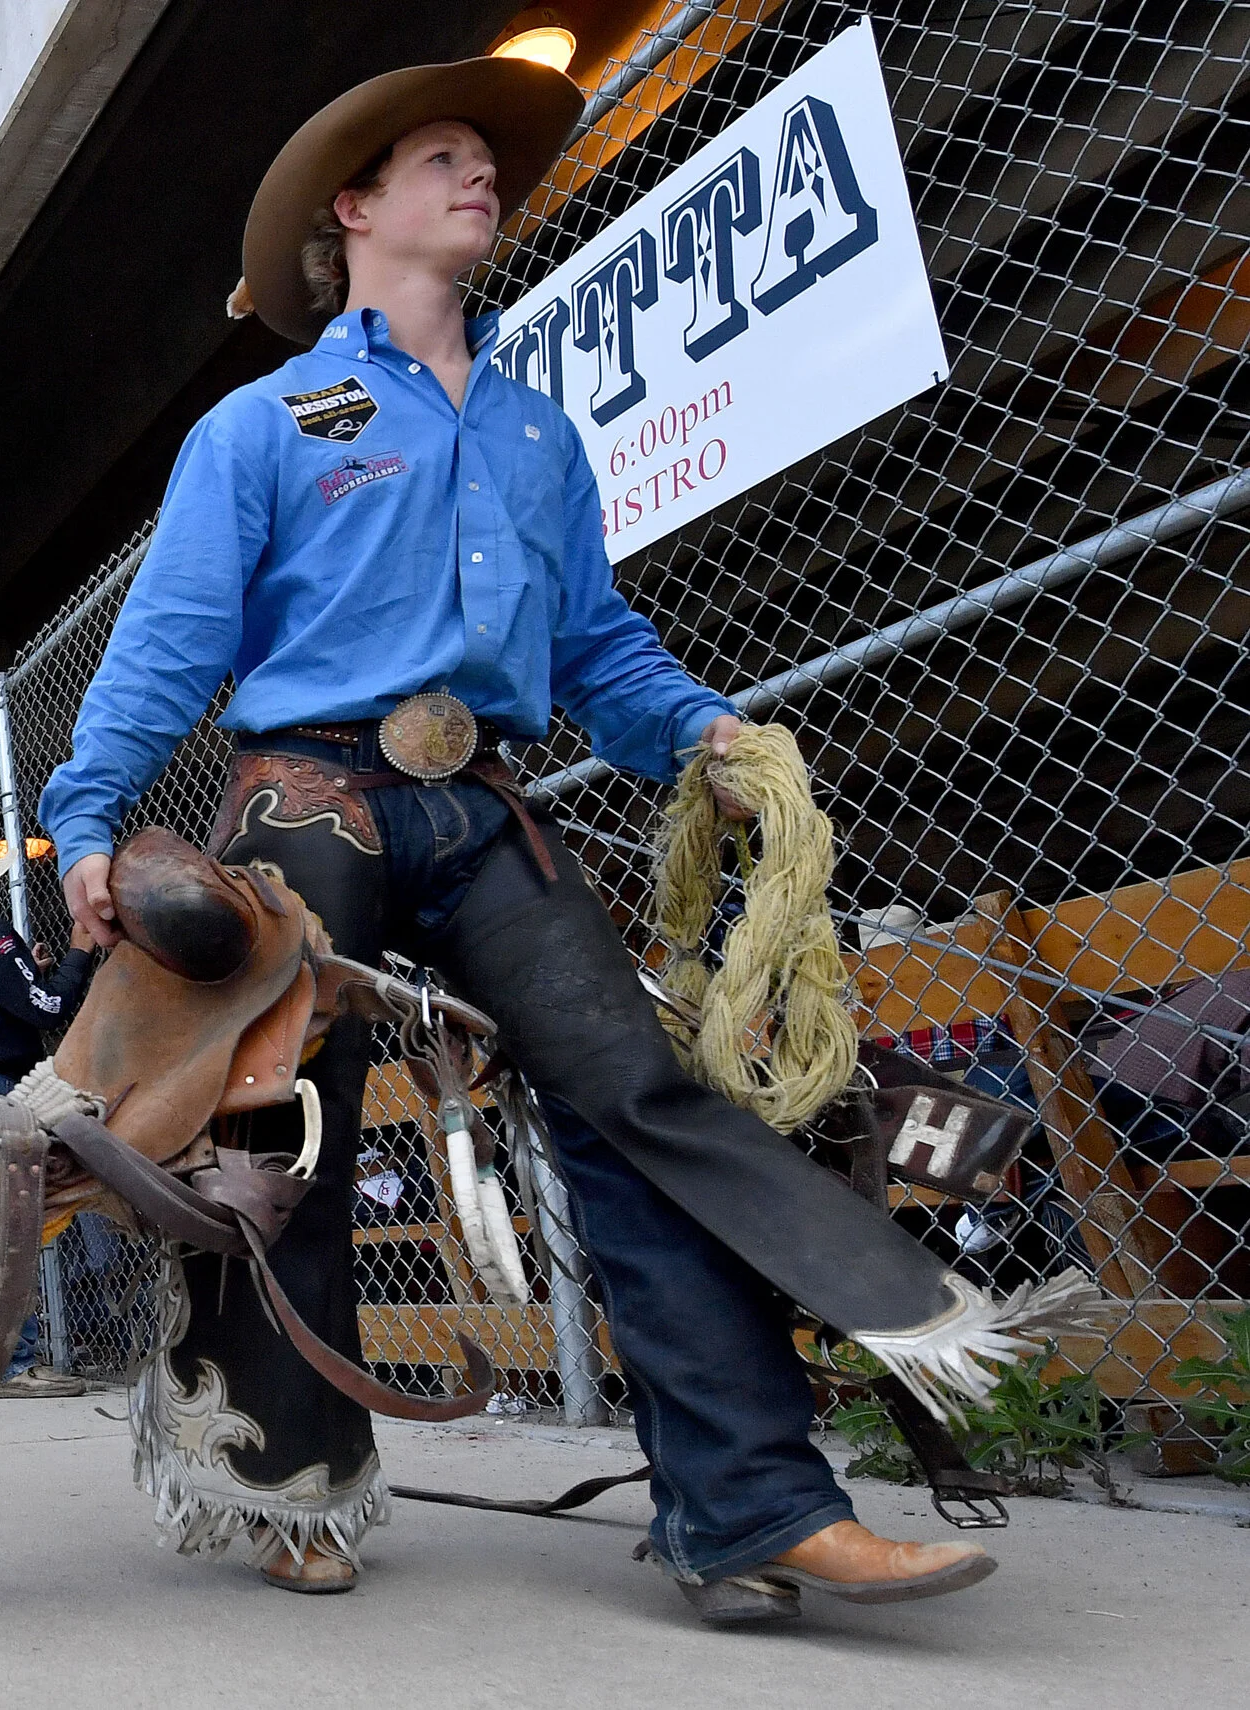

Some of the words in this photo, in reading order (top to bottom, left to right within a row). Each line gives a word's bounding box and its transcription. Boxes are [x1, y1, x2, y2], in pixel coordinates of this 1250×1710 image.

[291, 389, 369, 417] RESISTOL
[296, 385, 346, 402] TEAM
[299, 415, 323, 426] best
[323, 400, 373, 419] all-around
[609, 380, 734, 477] 6:00pm
[332, 466, 400, 499] SCOREBOARDS
[887, 1093, 971, 1179] H
